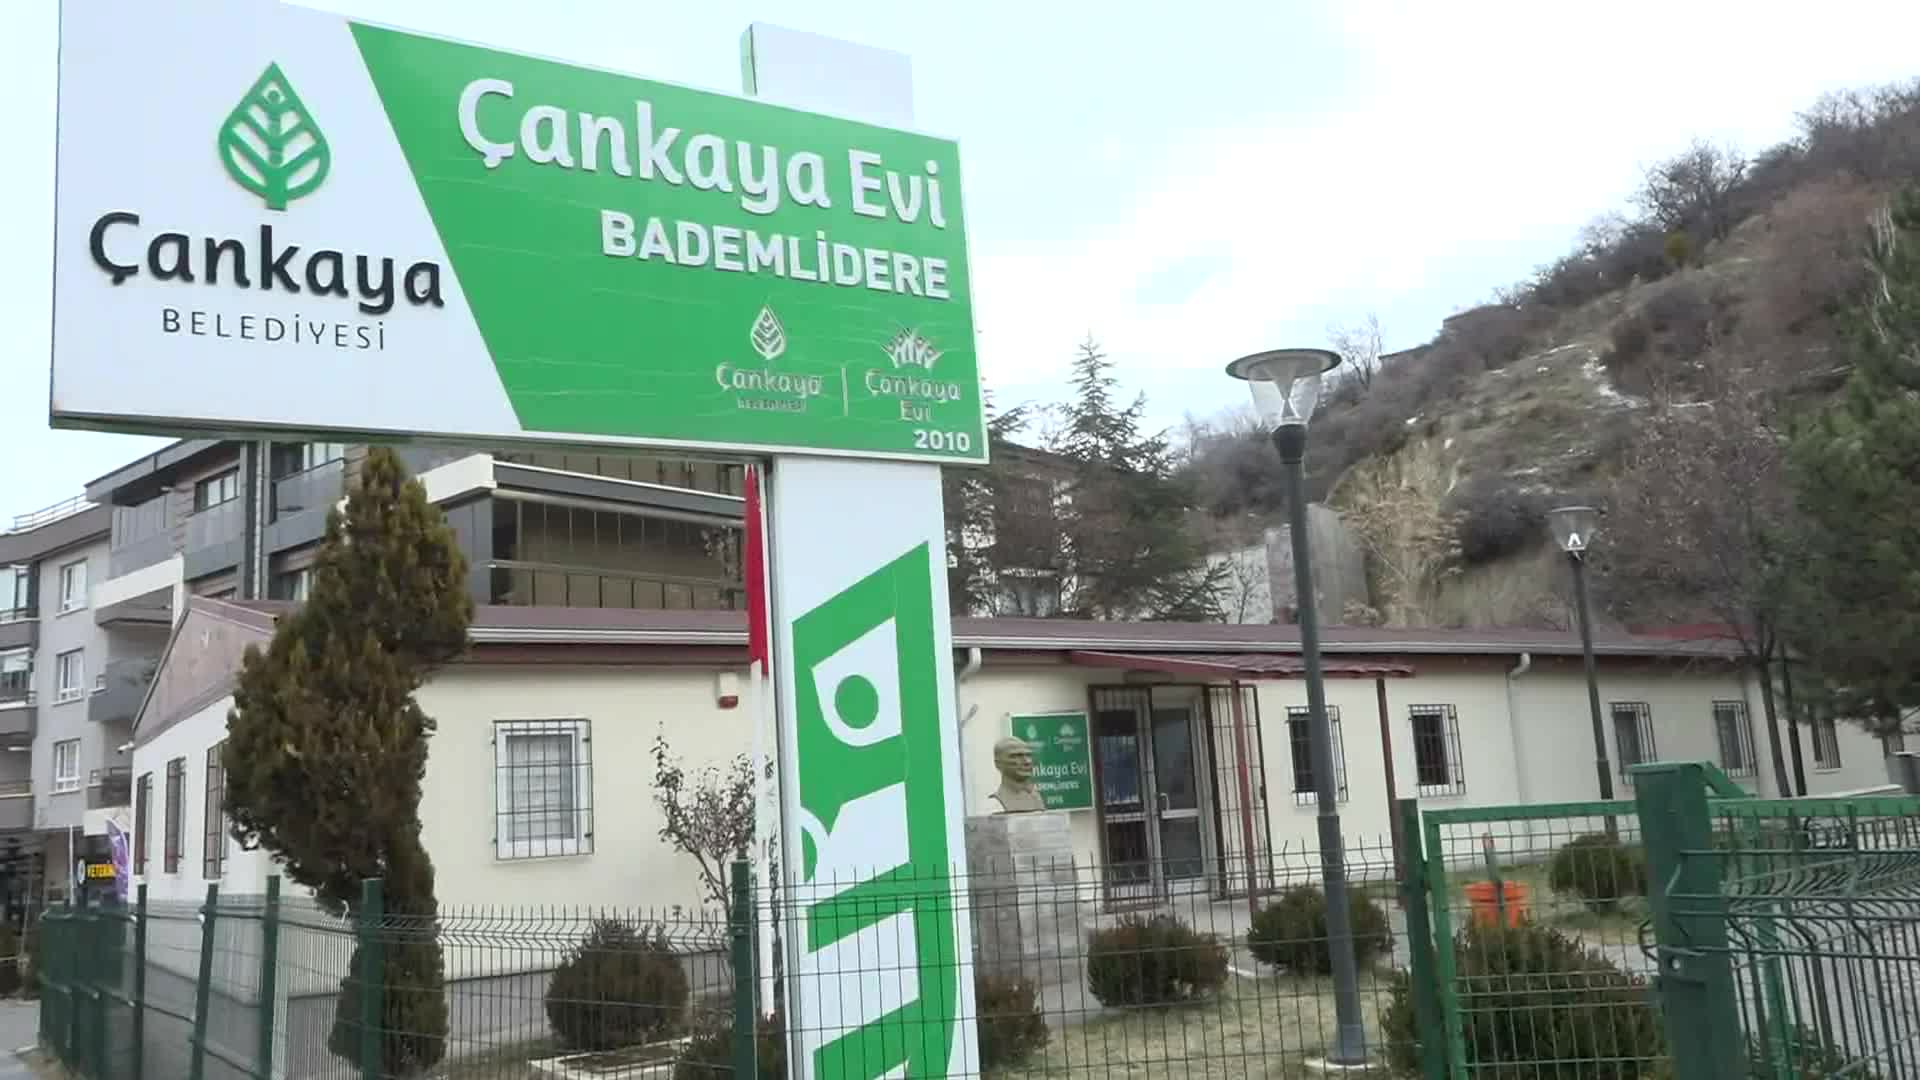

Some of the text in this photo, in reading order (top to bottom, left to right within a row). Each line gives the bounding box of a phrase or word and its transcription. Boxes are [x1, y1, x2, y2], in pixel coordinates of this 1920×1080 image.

[458, 78, 946, 229] Çankaya Evi
[89, 211, 444, 316] Çankaya
[600, 208, 951, 300] BADEMLİDERE
[162, 308, 384, 350] BELEDİYESİ
[716, 363, 822, 398] Çankaya
[865, 369, 961, 404] Çankaya
[900, 400, 931, 422] Evi
[913, 429, 970, 452] 2010
[1032, 762, 1069, 778] nkaya
